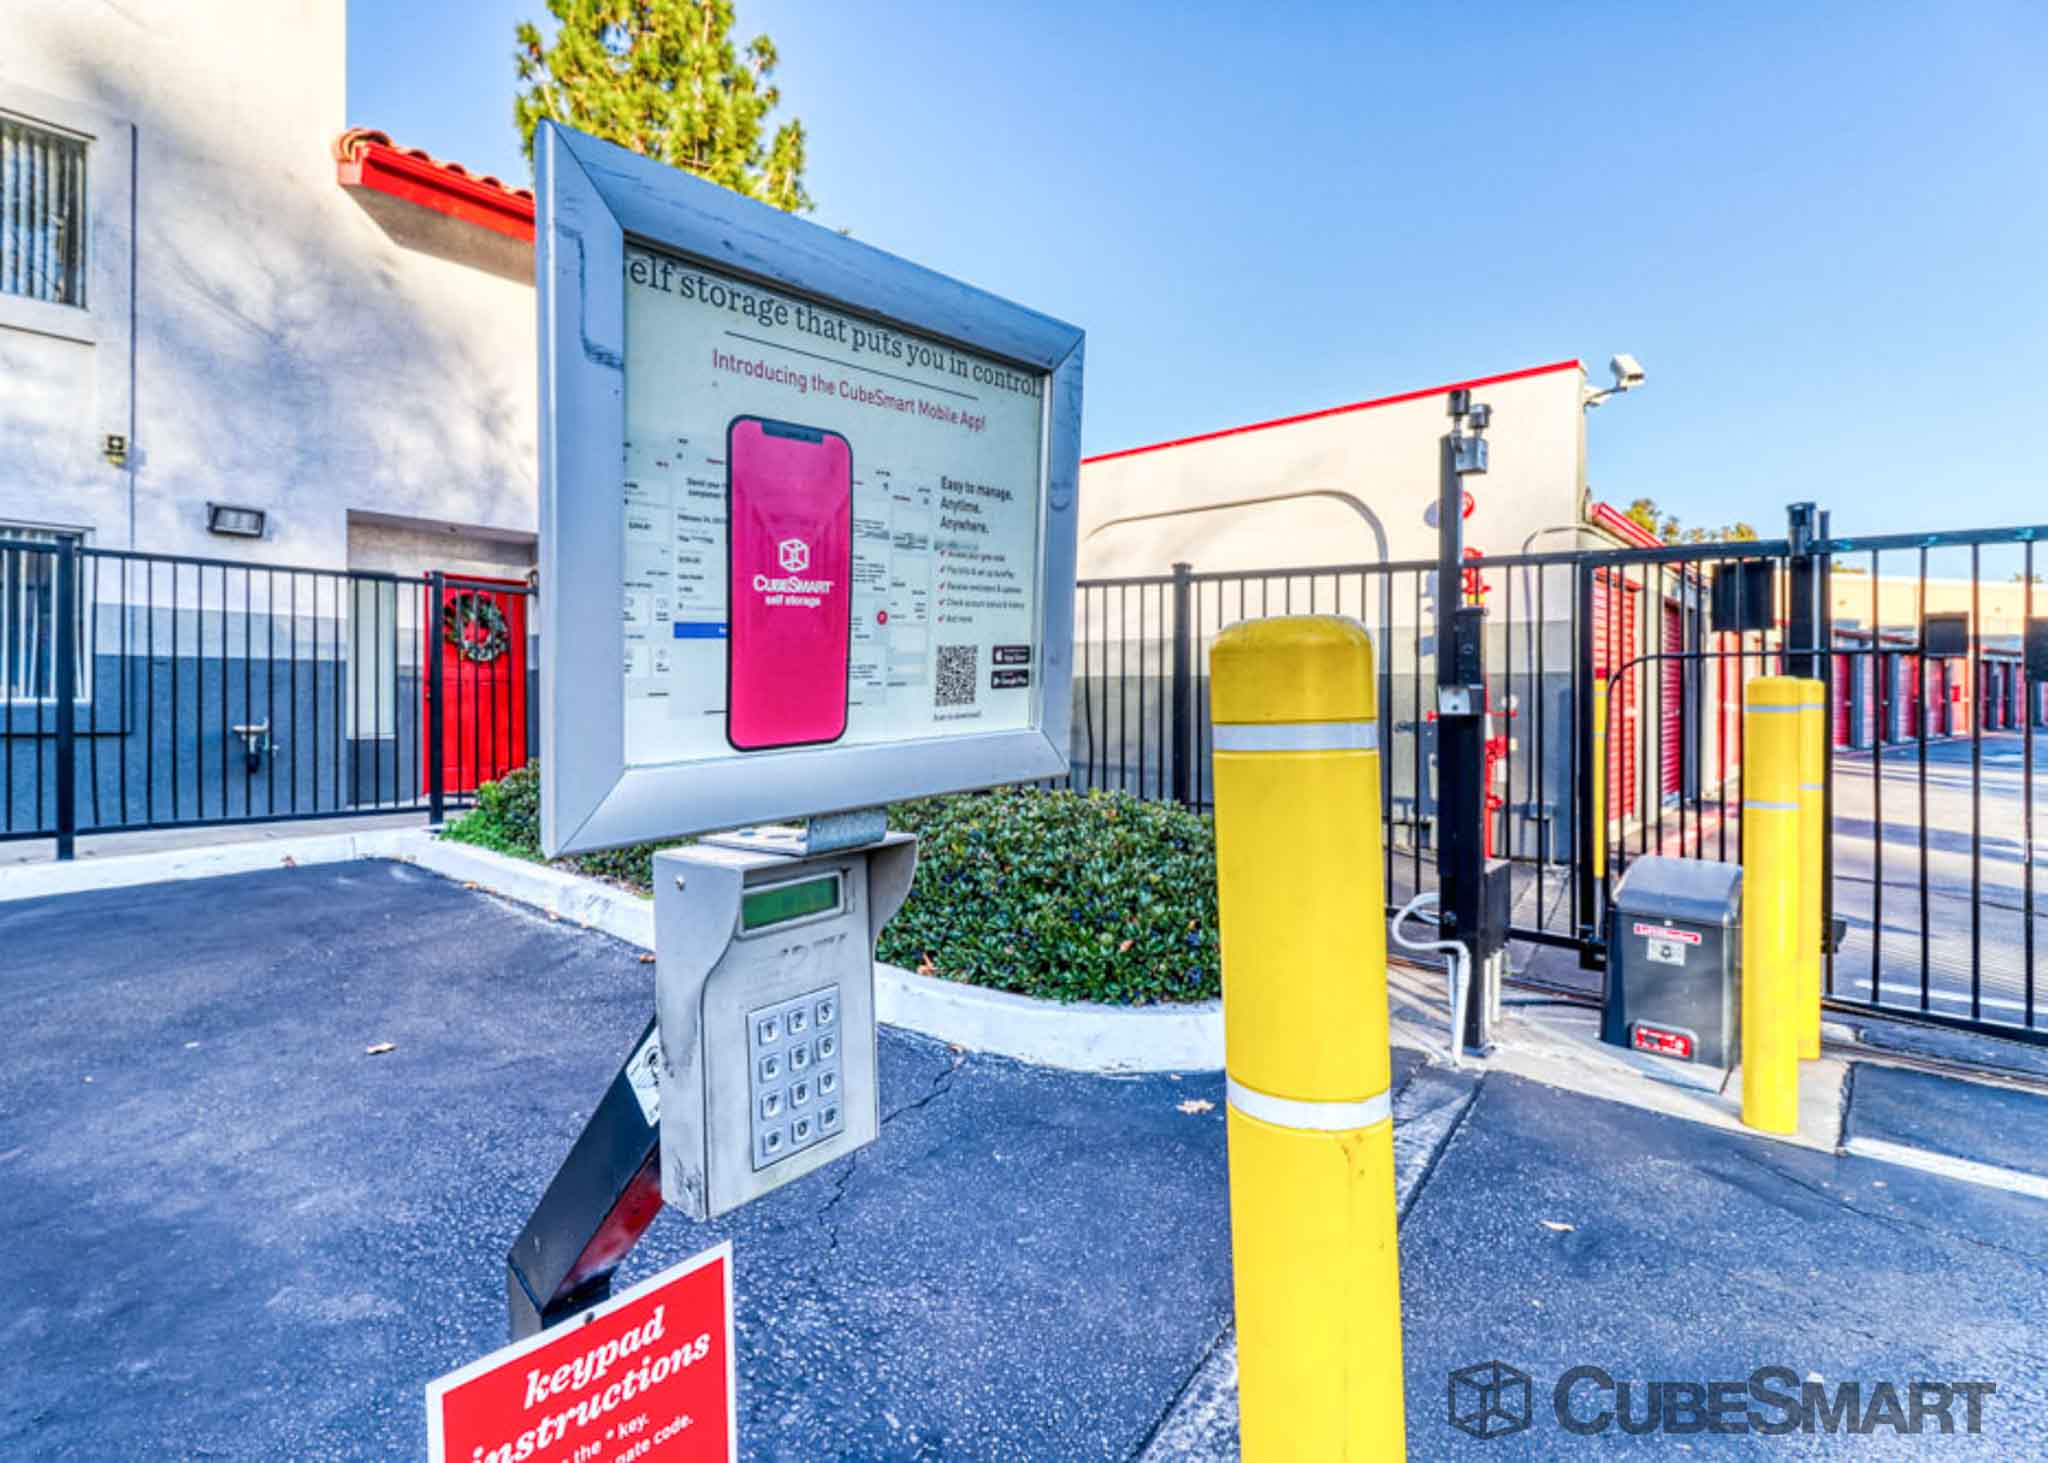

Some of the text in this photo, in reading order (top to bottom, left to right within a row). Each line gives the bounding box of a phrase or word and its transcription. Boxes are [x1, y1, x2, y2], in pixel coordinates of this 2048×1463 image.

[624, 255, 676, 293] elf
[681, 274, 788, 327] storage
[794, 303, 847, 343] that
[851, 326, 902, 359] puts
[906, 342, 945, 371] you
[949, 349, 968, 378] in
[712, 348, 986, 432] Introducing the CubeSmart Mobile App!
[941, 475, 963, 495] Easy
[524, 1304, 665, 1410] keypad
[573, 1413, 650, 1463] the key.
[653, 1414, 694, 1445] code.
